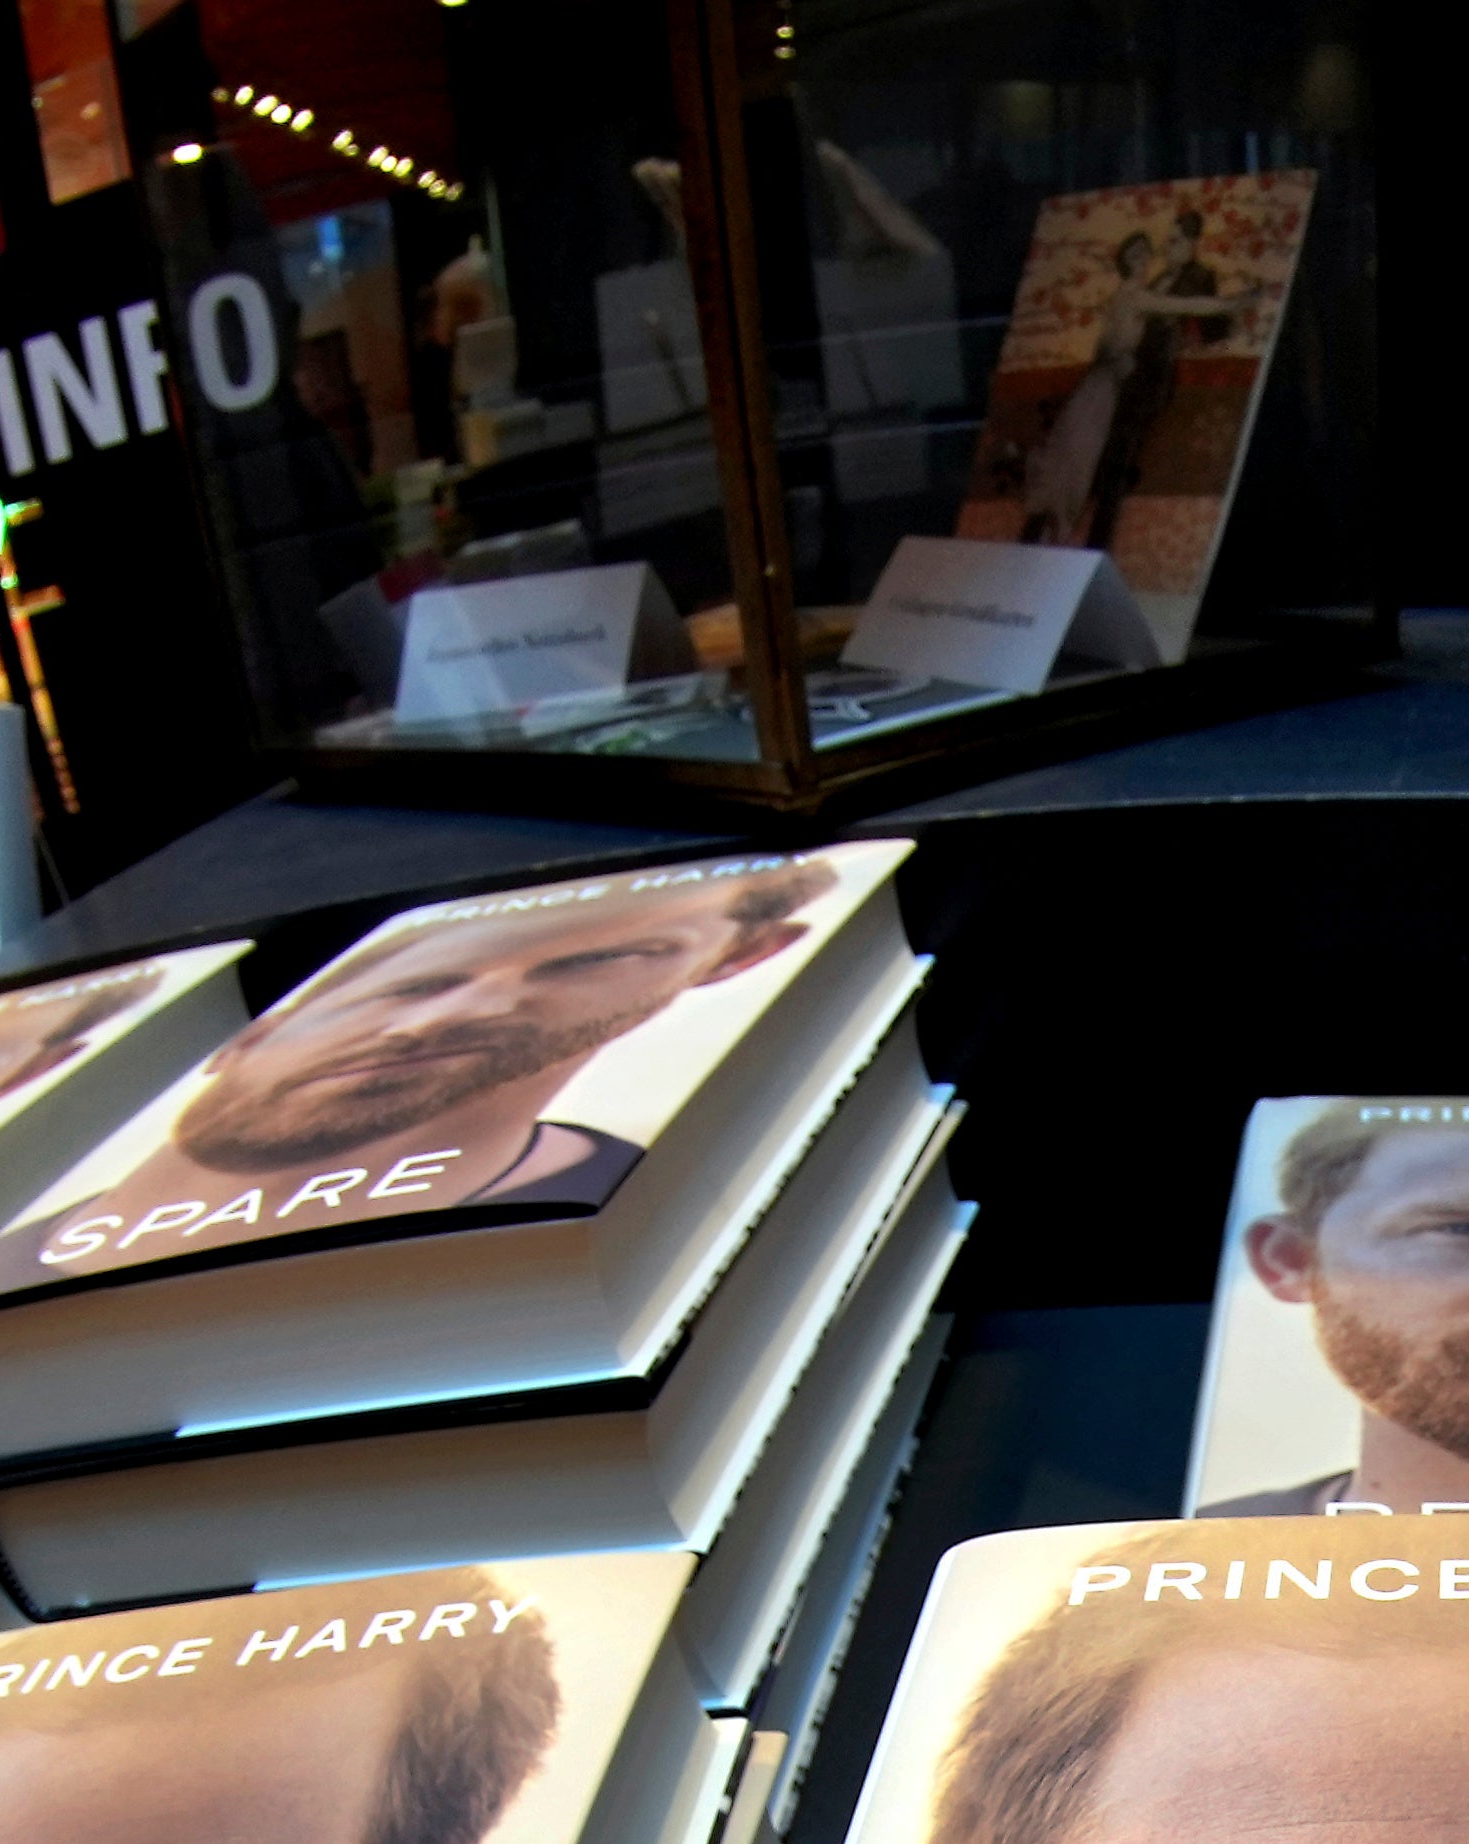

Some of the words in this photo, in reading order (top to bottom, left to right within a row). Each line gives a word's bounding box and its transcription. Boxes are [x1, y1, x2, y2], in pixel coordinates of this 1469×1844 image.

[630, 852, 809, 893] HARRY
[39, 1147, 463, 1268] SPARE
[235, 1597, 531, 1668] HARRY
